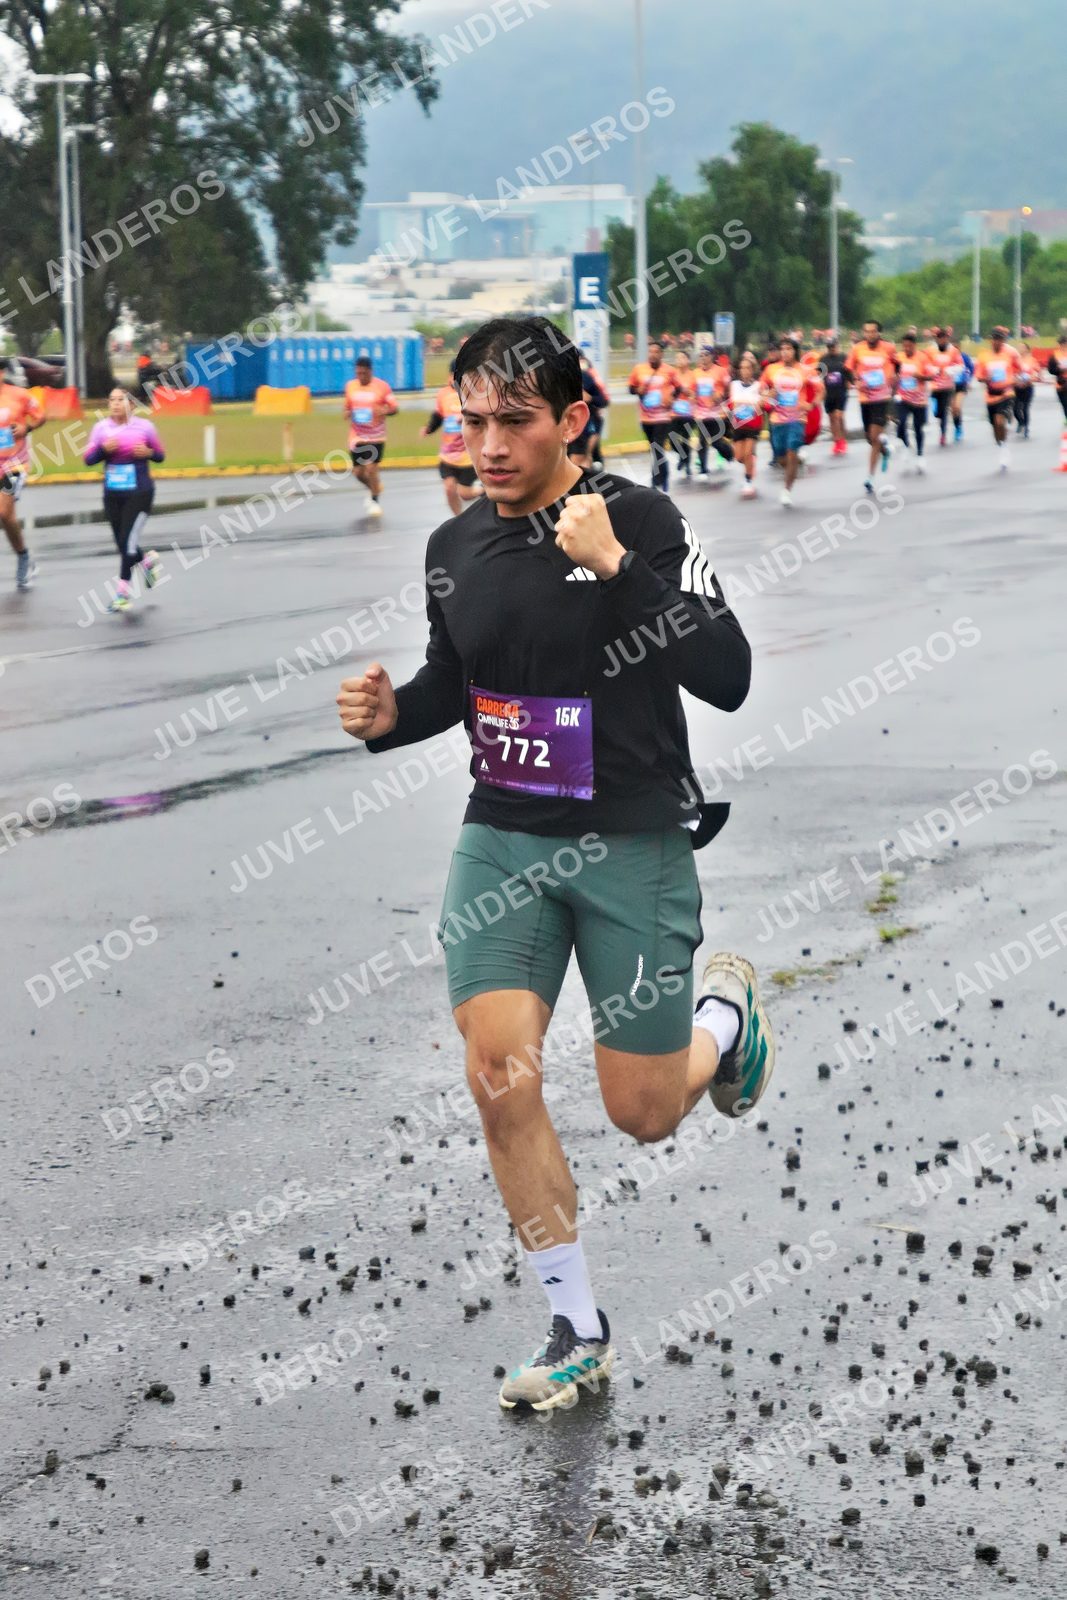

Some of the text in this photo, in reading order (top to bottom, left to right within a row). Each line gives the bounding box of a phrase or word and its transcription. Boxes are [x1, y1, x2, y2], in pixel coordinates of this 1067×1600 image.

[579, 276, 600, 303] E
[476, 696, 519, 718] CARRERA
[498, 734, 550, 768] 772
